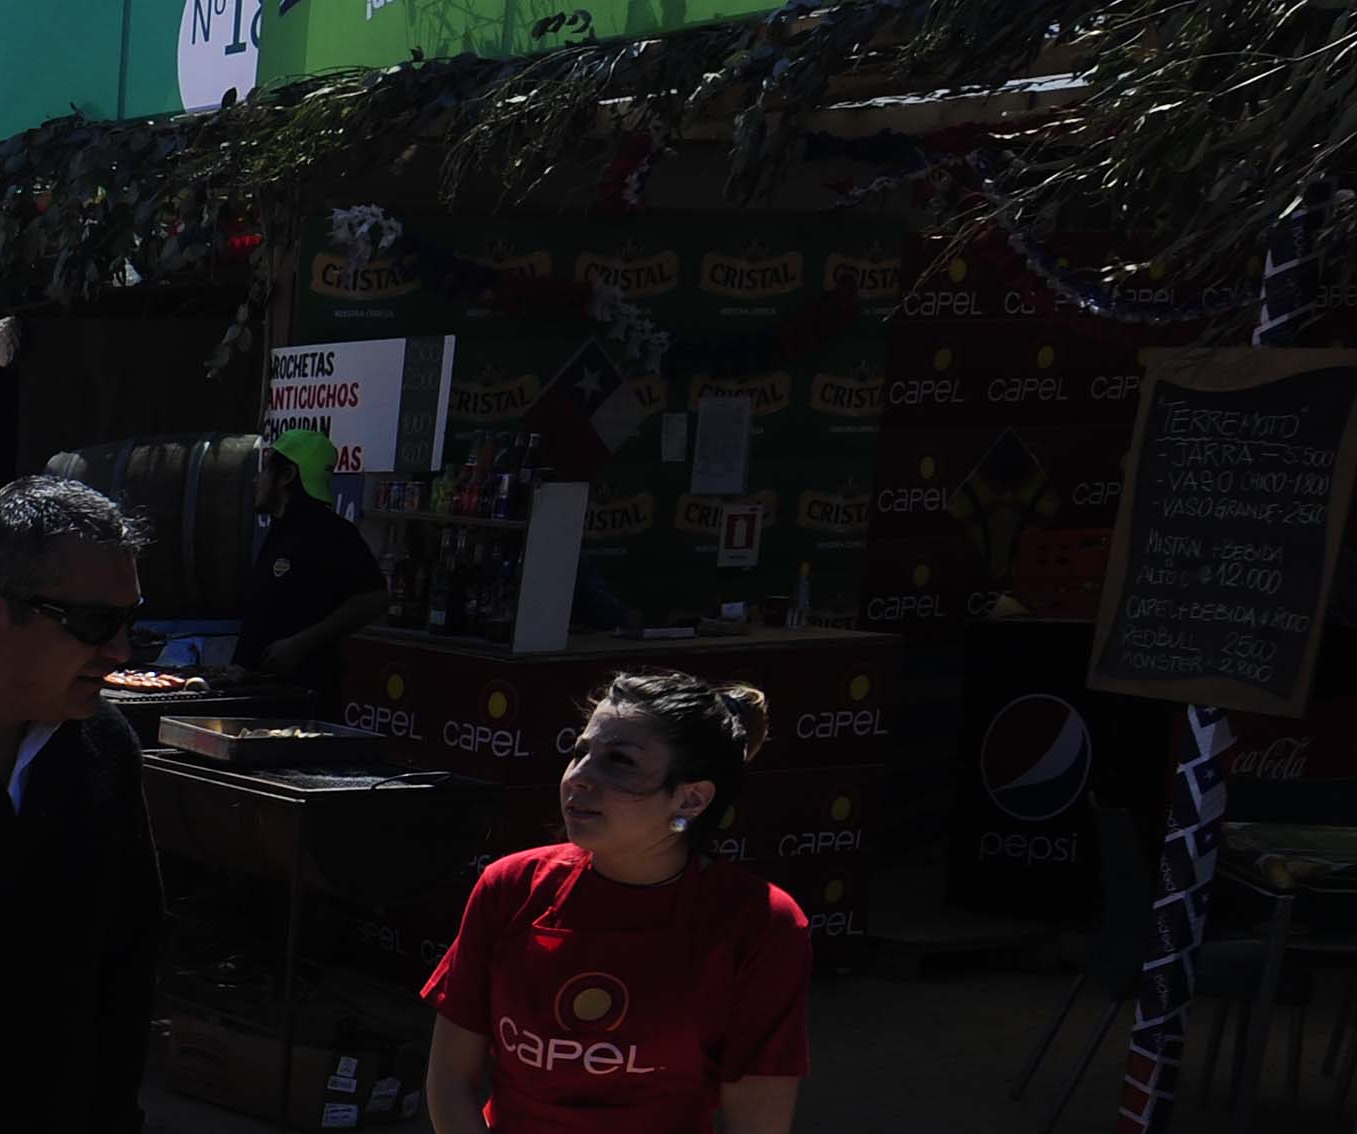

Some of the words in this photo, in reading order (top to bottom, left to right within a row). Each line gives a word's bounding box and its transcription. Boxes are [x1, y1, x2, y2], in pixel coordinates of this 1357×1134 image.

[710, 262, 797, 288] CRISTAL
[268, 382, 359, 411] ANTICUCHOS
[979, 832, 1078, 866] pepsi
